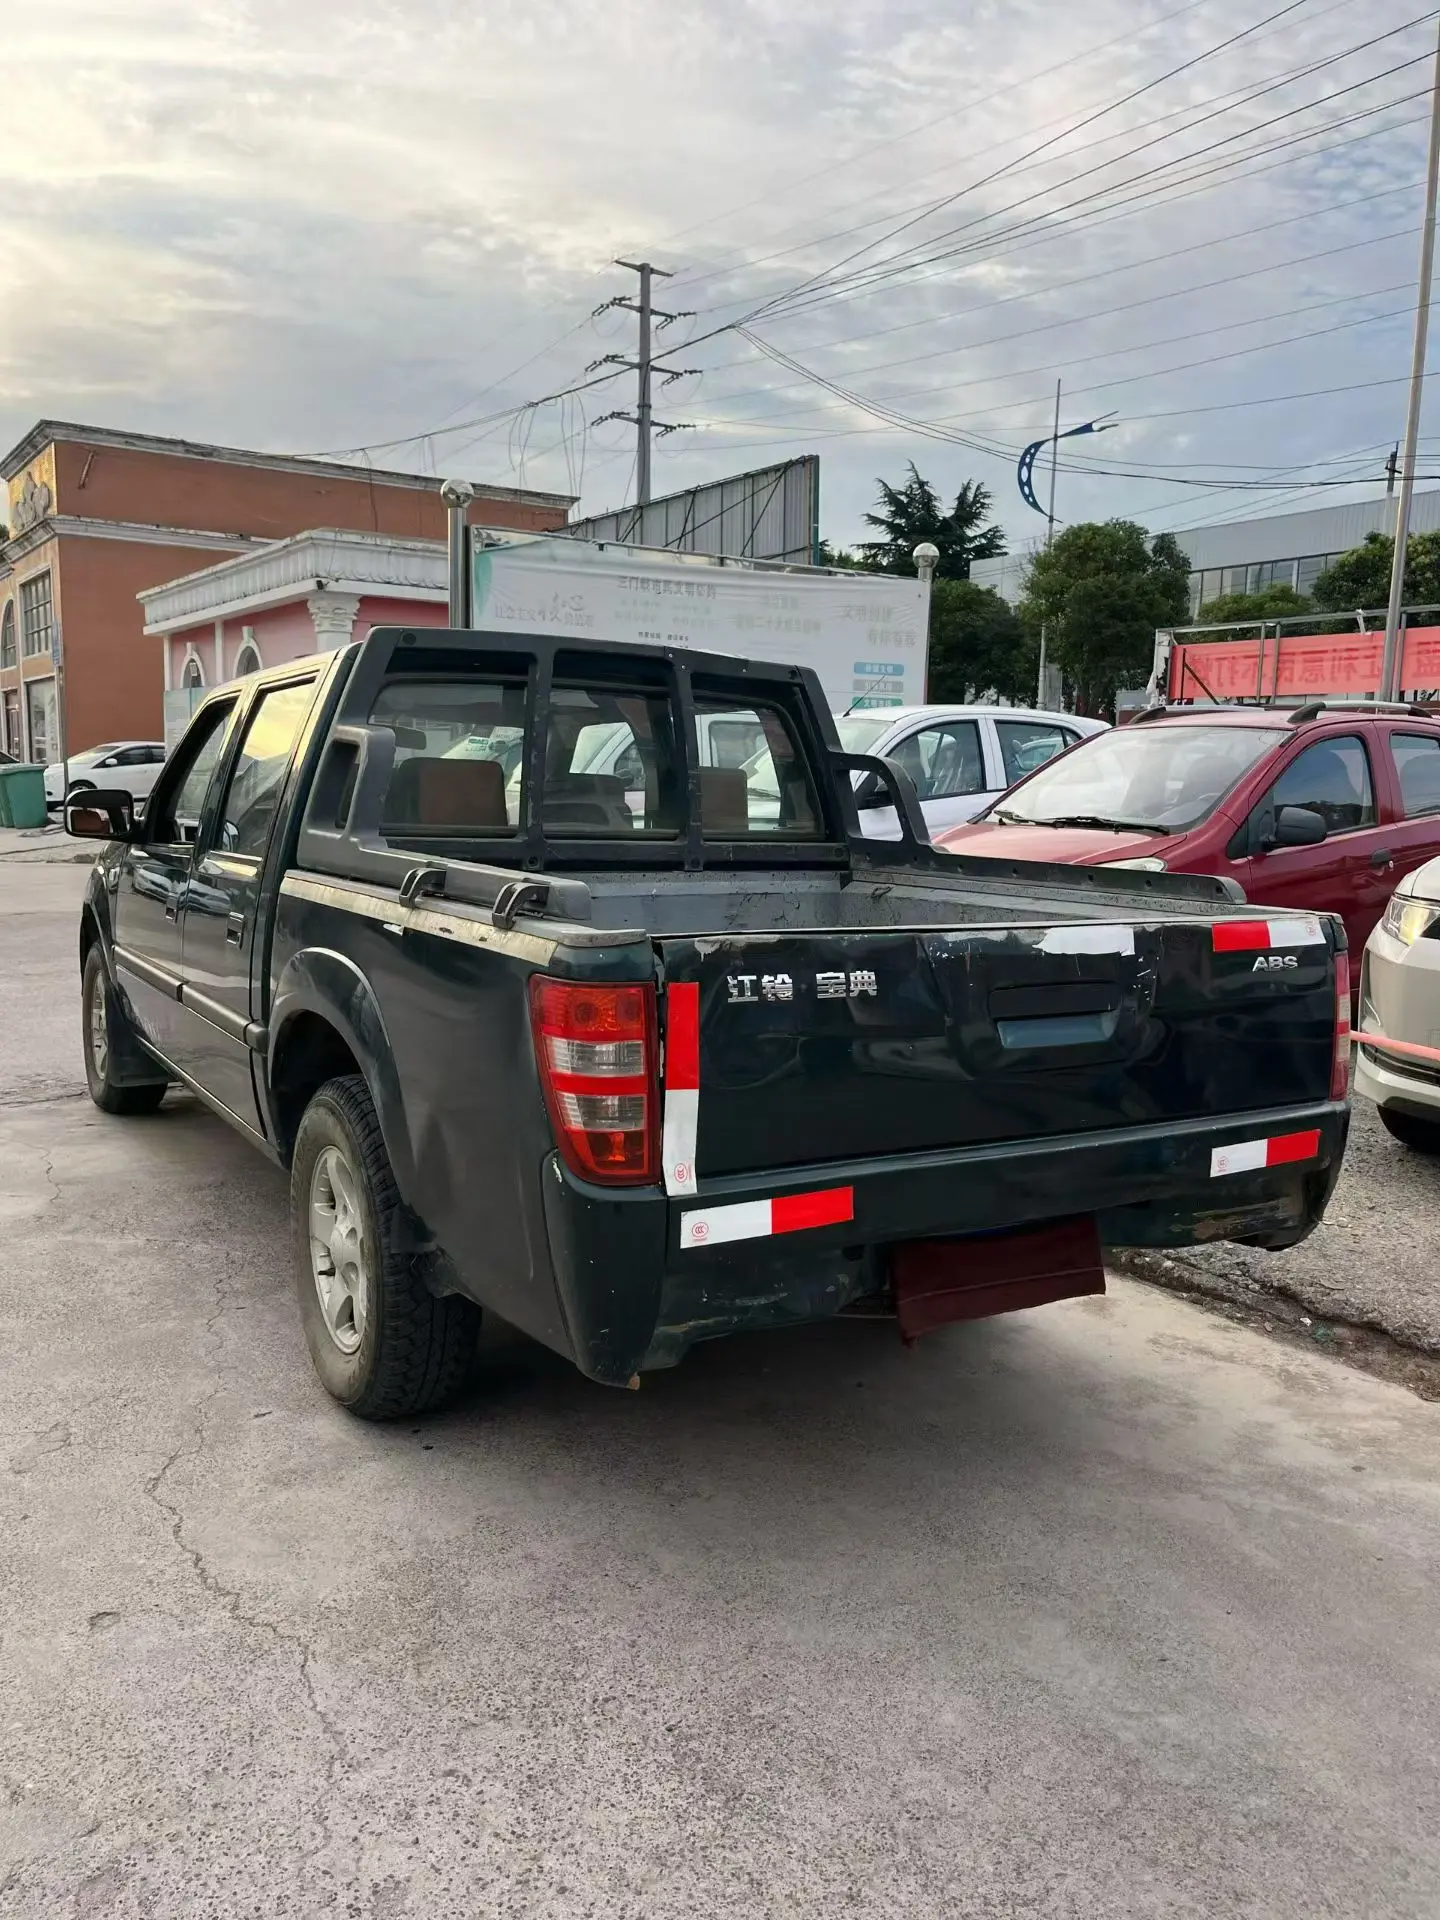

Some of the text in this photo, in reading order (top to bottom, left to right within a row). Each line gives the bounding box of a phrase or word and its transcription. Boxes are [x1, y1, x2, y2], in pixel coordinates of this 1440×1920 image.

[1251, 955, 1299, 973] ABS
[726, 970, 878, 1003] 江铃 宝典
